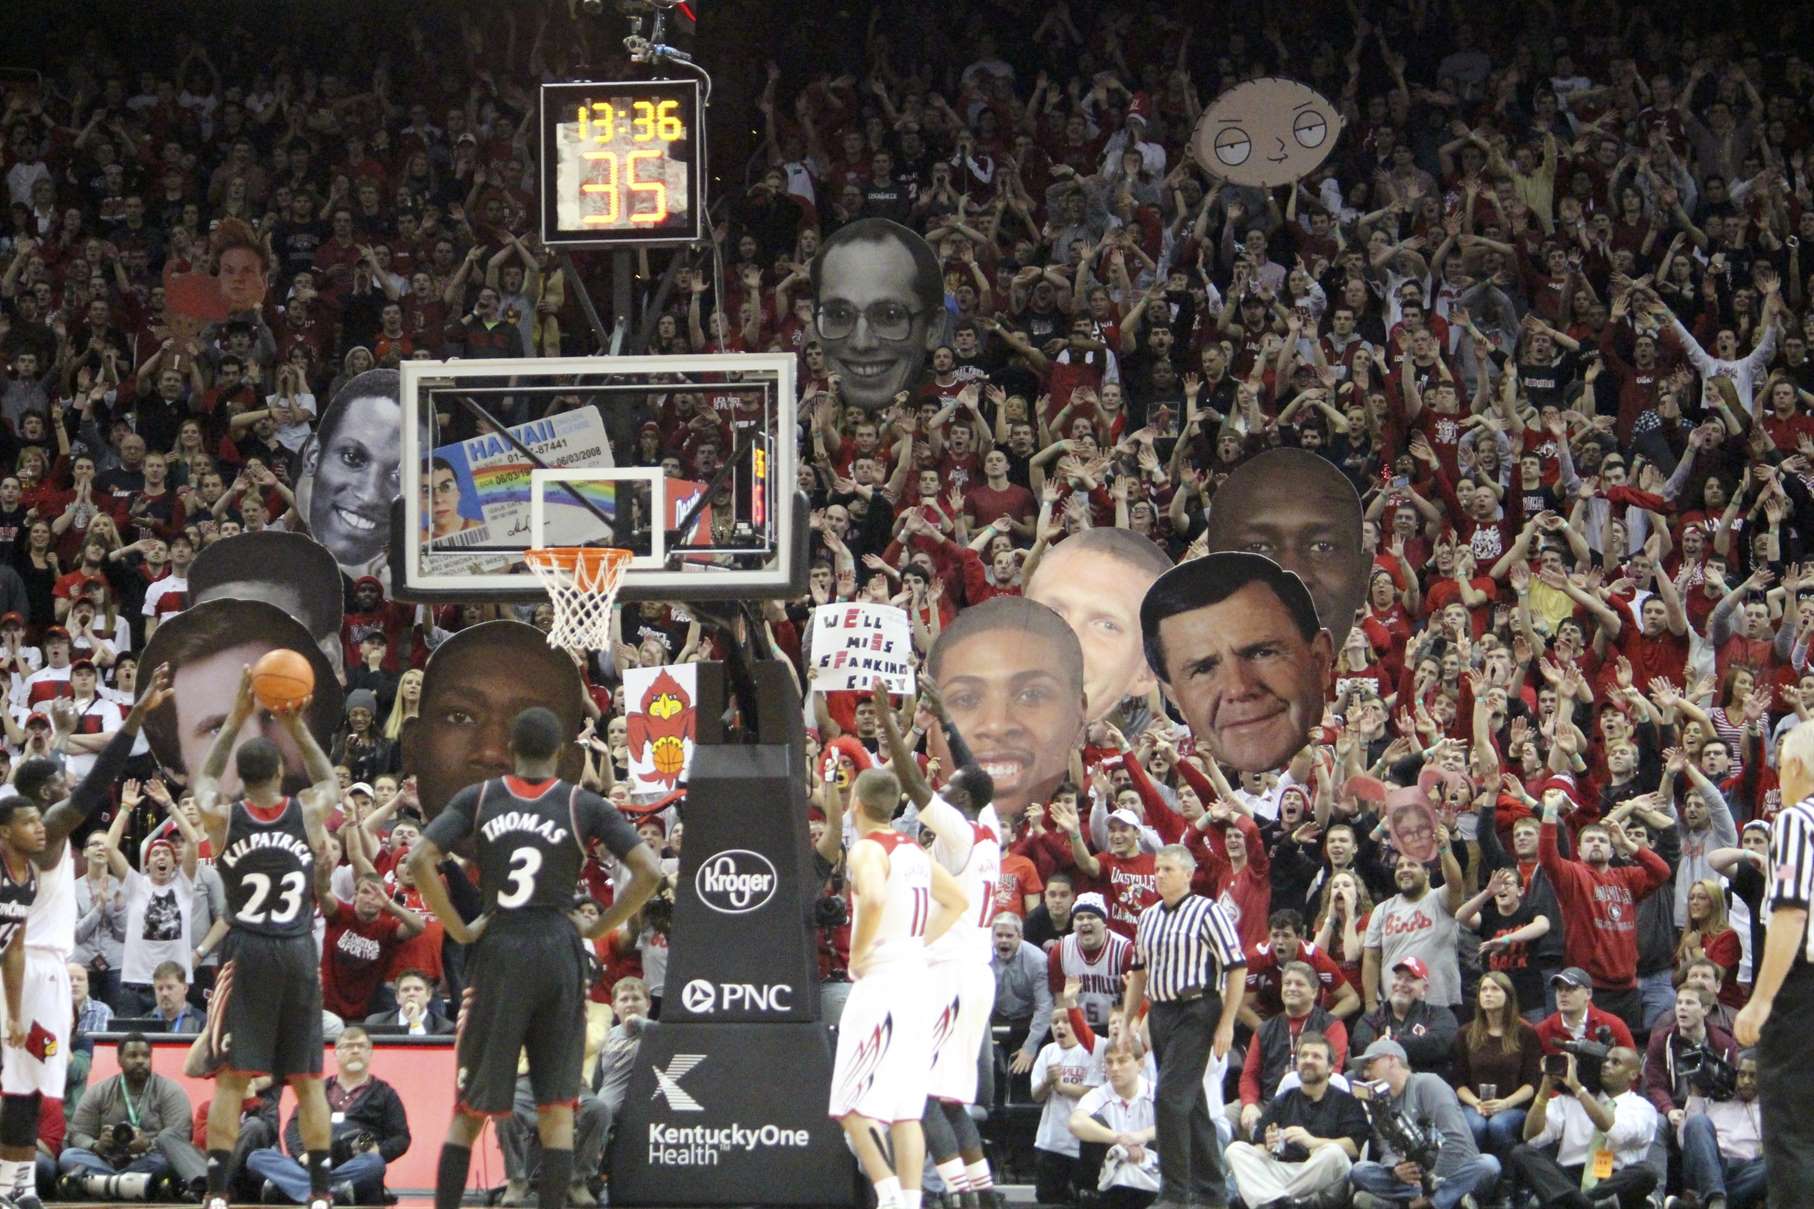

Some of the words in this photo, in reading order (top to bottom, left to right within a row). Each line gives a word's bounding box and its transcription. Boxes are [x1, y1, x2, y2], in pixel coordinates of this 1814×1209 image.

[577, 100, 682, 143] 13:36
[581, 150, 667, 224] 35
[469, 419, 557, 462] HAWAII
[819, 650, 908, 675] SPANKING
[846, 633, 894, 653] MISS
[480, 811, 568, 844] THOMAS
[222, 832, 313, 869] KILPATRICK
[235, 871, 306, 924] 23
[497, 846, 543, 909] 3
[704, 857, 774, 907] Kroger
[910, 887, 929, 938] 11
[720, 983, 792, 1011] PNC
[648, 1143, 718, 1165] Health
[649, 1123, 809, 1150] KentuckyOne
